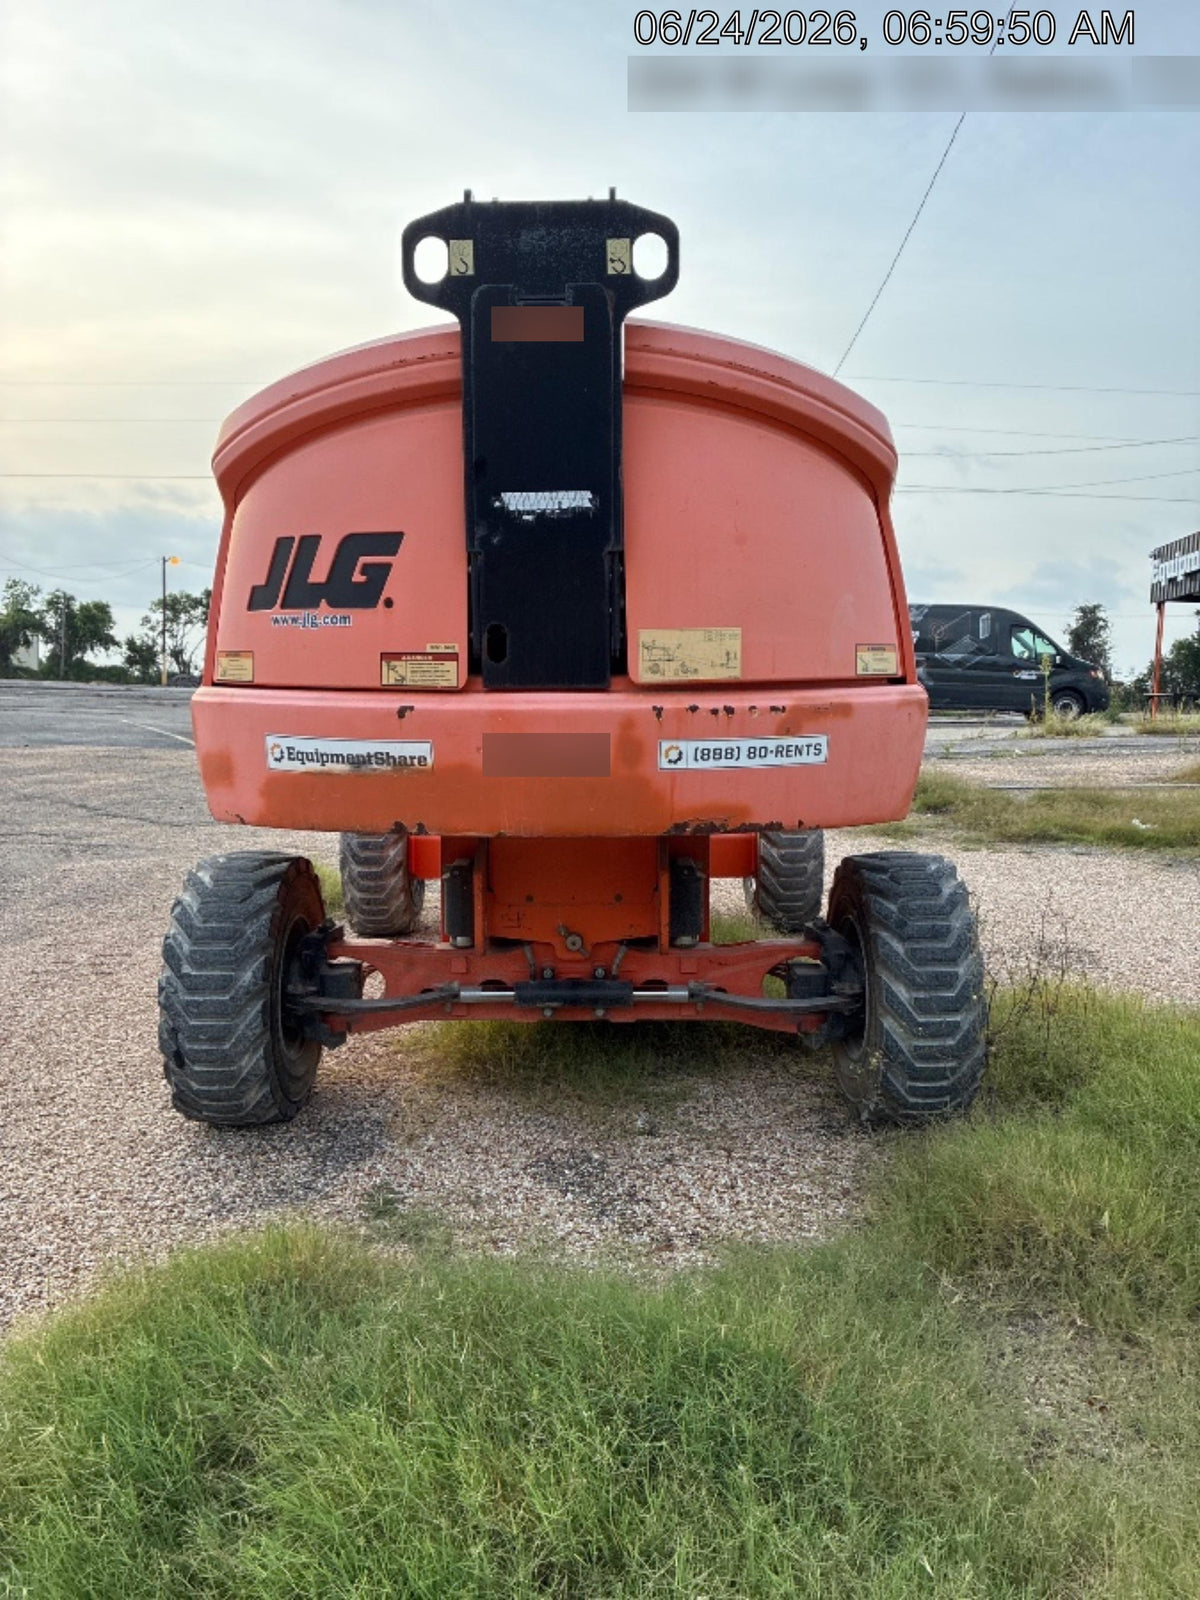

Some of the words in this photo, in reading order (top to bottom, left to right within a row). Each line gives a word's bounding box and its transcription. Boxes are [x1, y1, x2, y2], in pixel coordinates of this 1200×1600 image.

[247, 532, 404, 611] JLG
[272, 612, 352, 628] www.jlg.com
[286, 746, 428, 768] EquipmentShare
[694, 746, 741, 762] (888)
[747, 743, 823, 759] 80-RENTS
